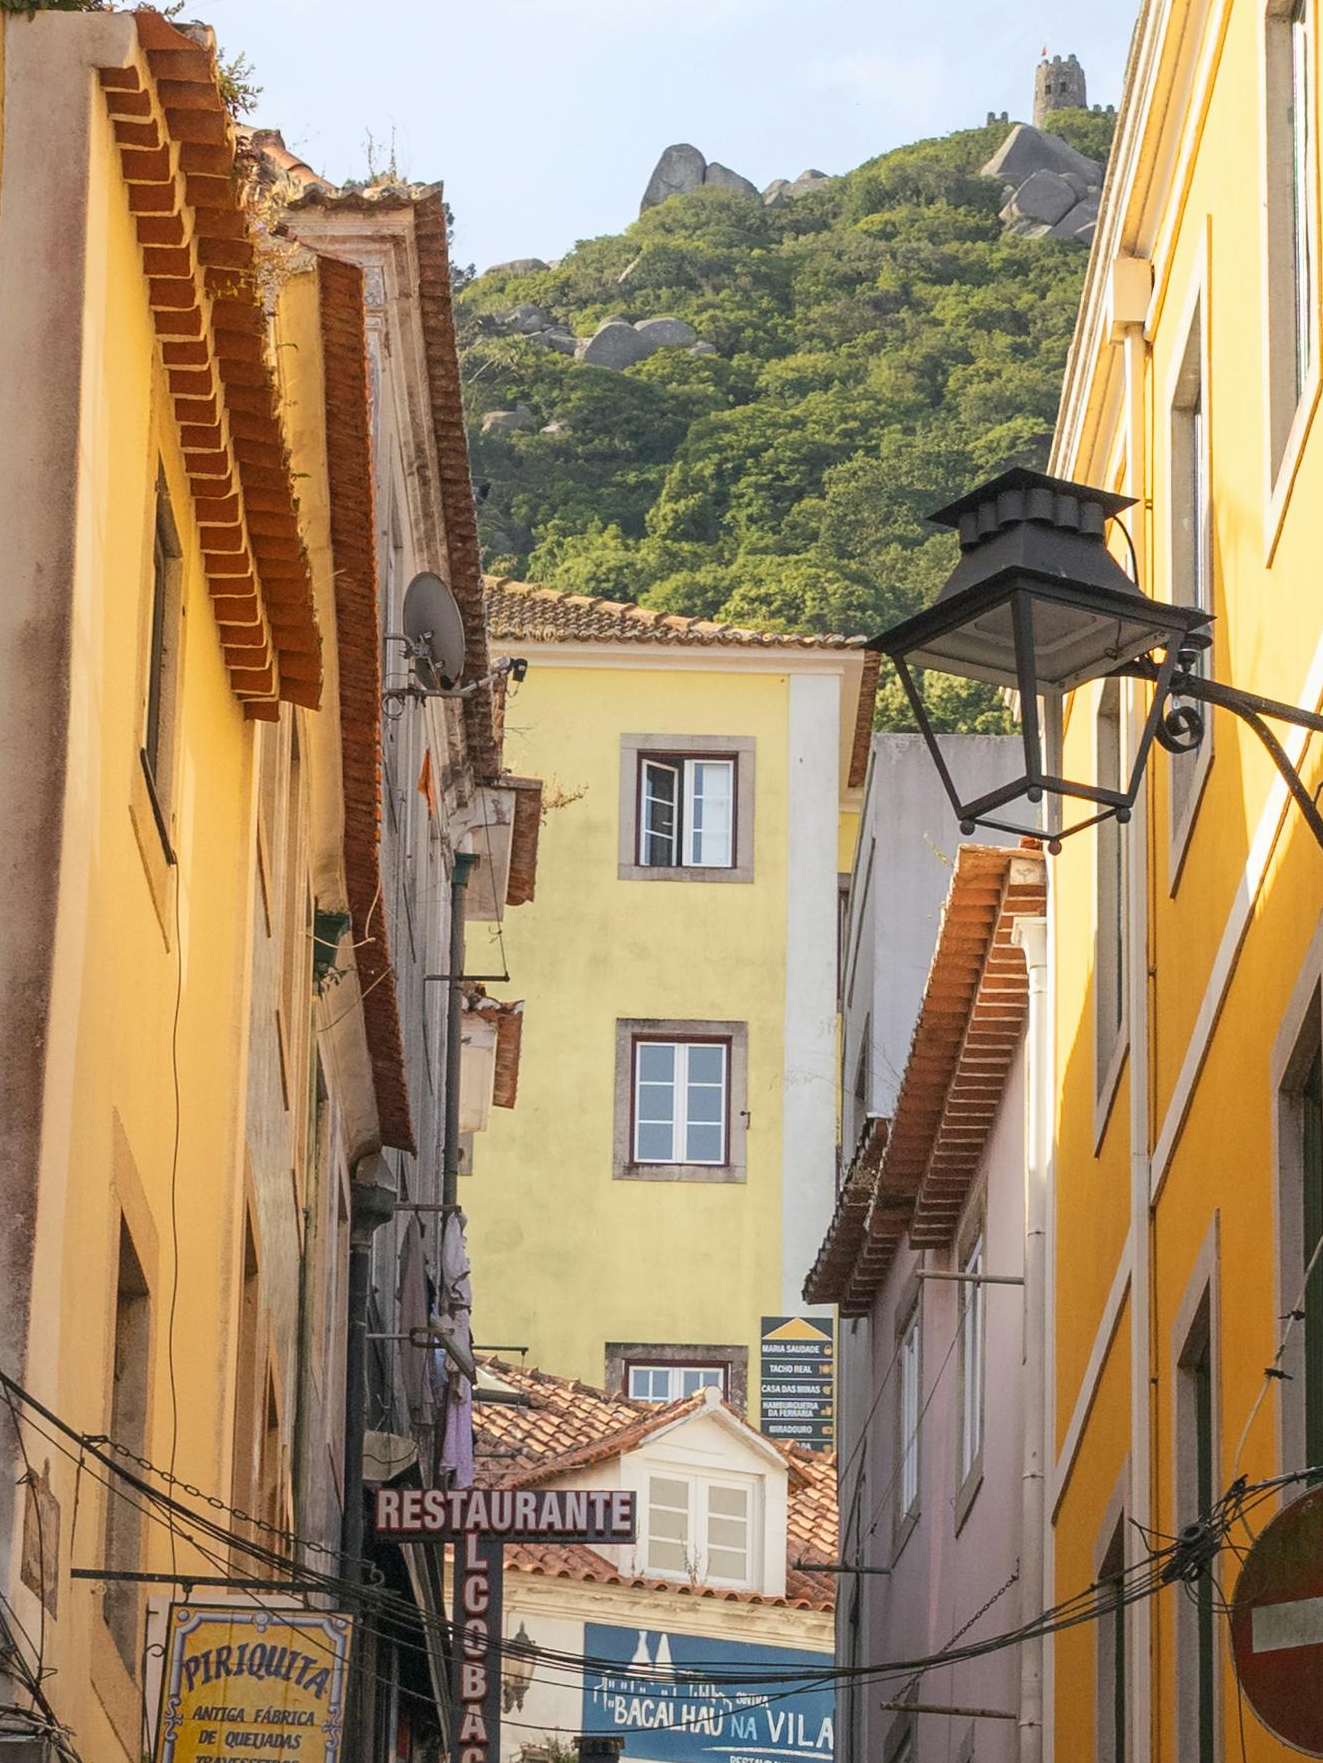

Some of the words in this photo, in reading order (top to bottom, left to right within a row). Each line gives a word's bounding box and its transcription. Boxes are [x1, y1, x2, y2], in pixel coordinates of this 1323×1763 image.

[762, 1344, 785, 1353] MARIA
[786, 1345, 820, 1354] SAUDADE
[769, 1364, 793, 1373] TACHO
[794, 1365, 812, 1373] REAL
[761, 1385, 780, 1393] CASA
[781, 1385, 796, 1393] DAS
[768, 1409, 778, 1417] DA
[769, 1425, 813, 1434] MIRADOURO
[378, 1490, 632, 1532] RESTAURANTE
[182, 1642, 331, 1700] PIRIQUITA
[192, 1705, 245, 1723] ANTIGA
[254, 1705, 315, 1726] FÁBRICA
[614, 1697, 724, 1737] BACALHAU
[731, 1716, 757, 1741] NA
[766, 1710, 834, 1750] VILA
[198, 1729, 217, 1745] DE
[225, 1731, 302, 1750] QUEIJADAS
